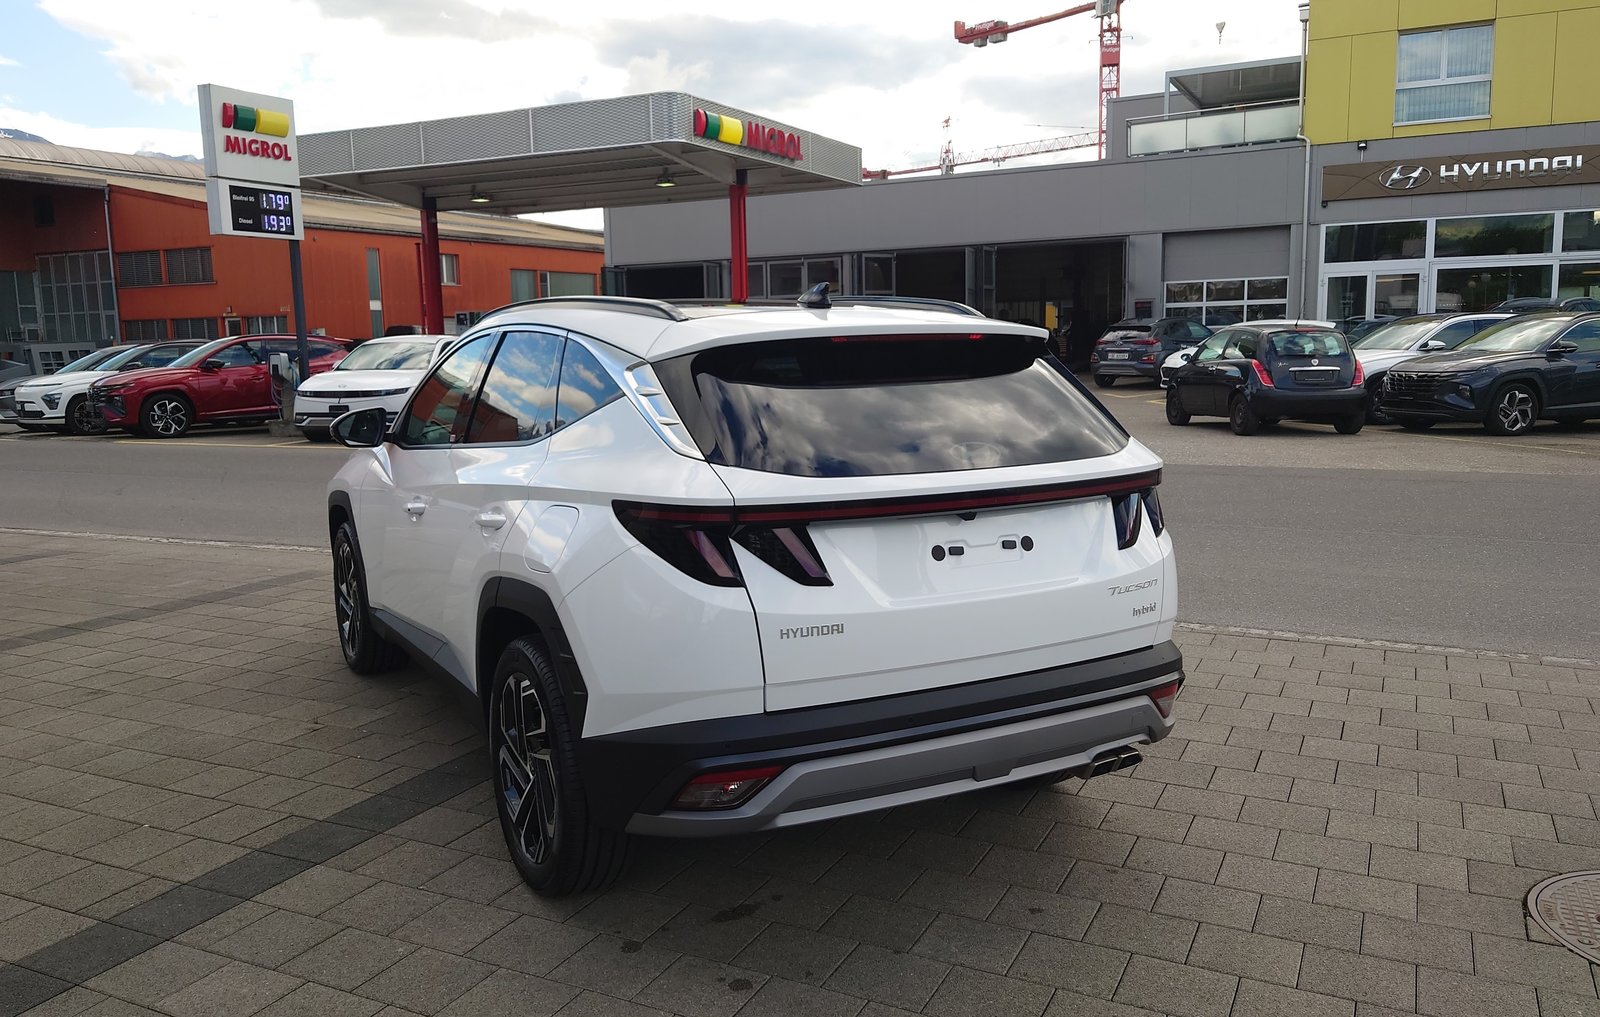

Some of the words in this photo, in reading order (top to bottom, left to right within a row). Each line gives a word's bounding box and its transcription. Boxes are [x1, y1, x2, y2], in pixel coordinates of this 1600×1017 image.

[224, 135, 292, 161] MIGROL
[746, 121, 803, 160] MIGROL
[1439, 155, 1583, 183] HYUNDAI
[238, 217, 253, 225] Diesel
[1132, 602, 1157, 617] hybrid
[780, 623, 844, 639] HYUNDAI
